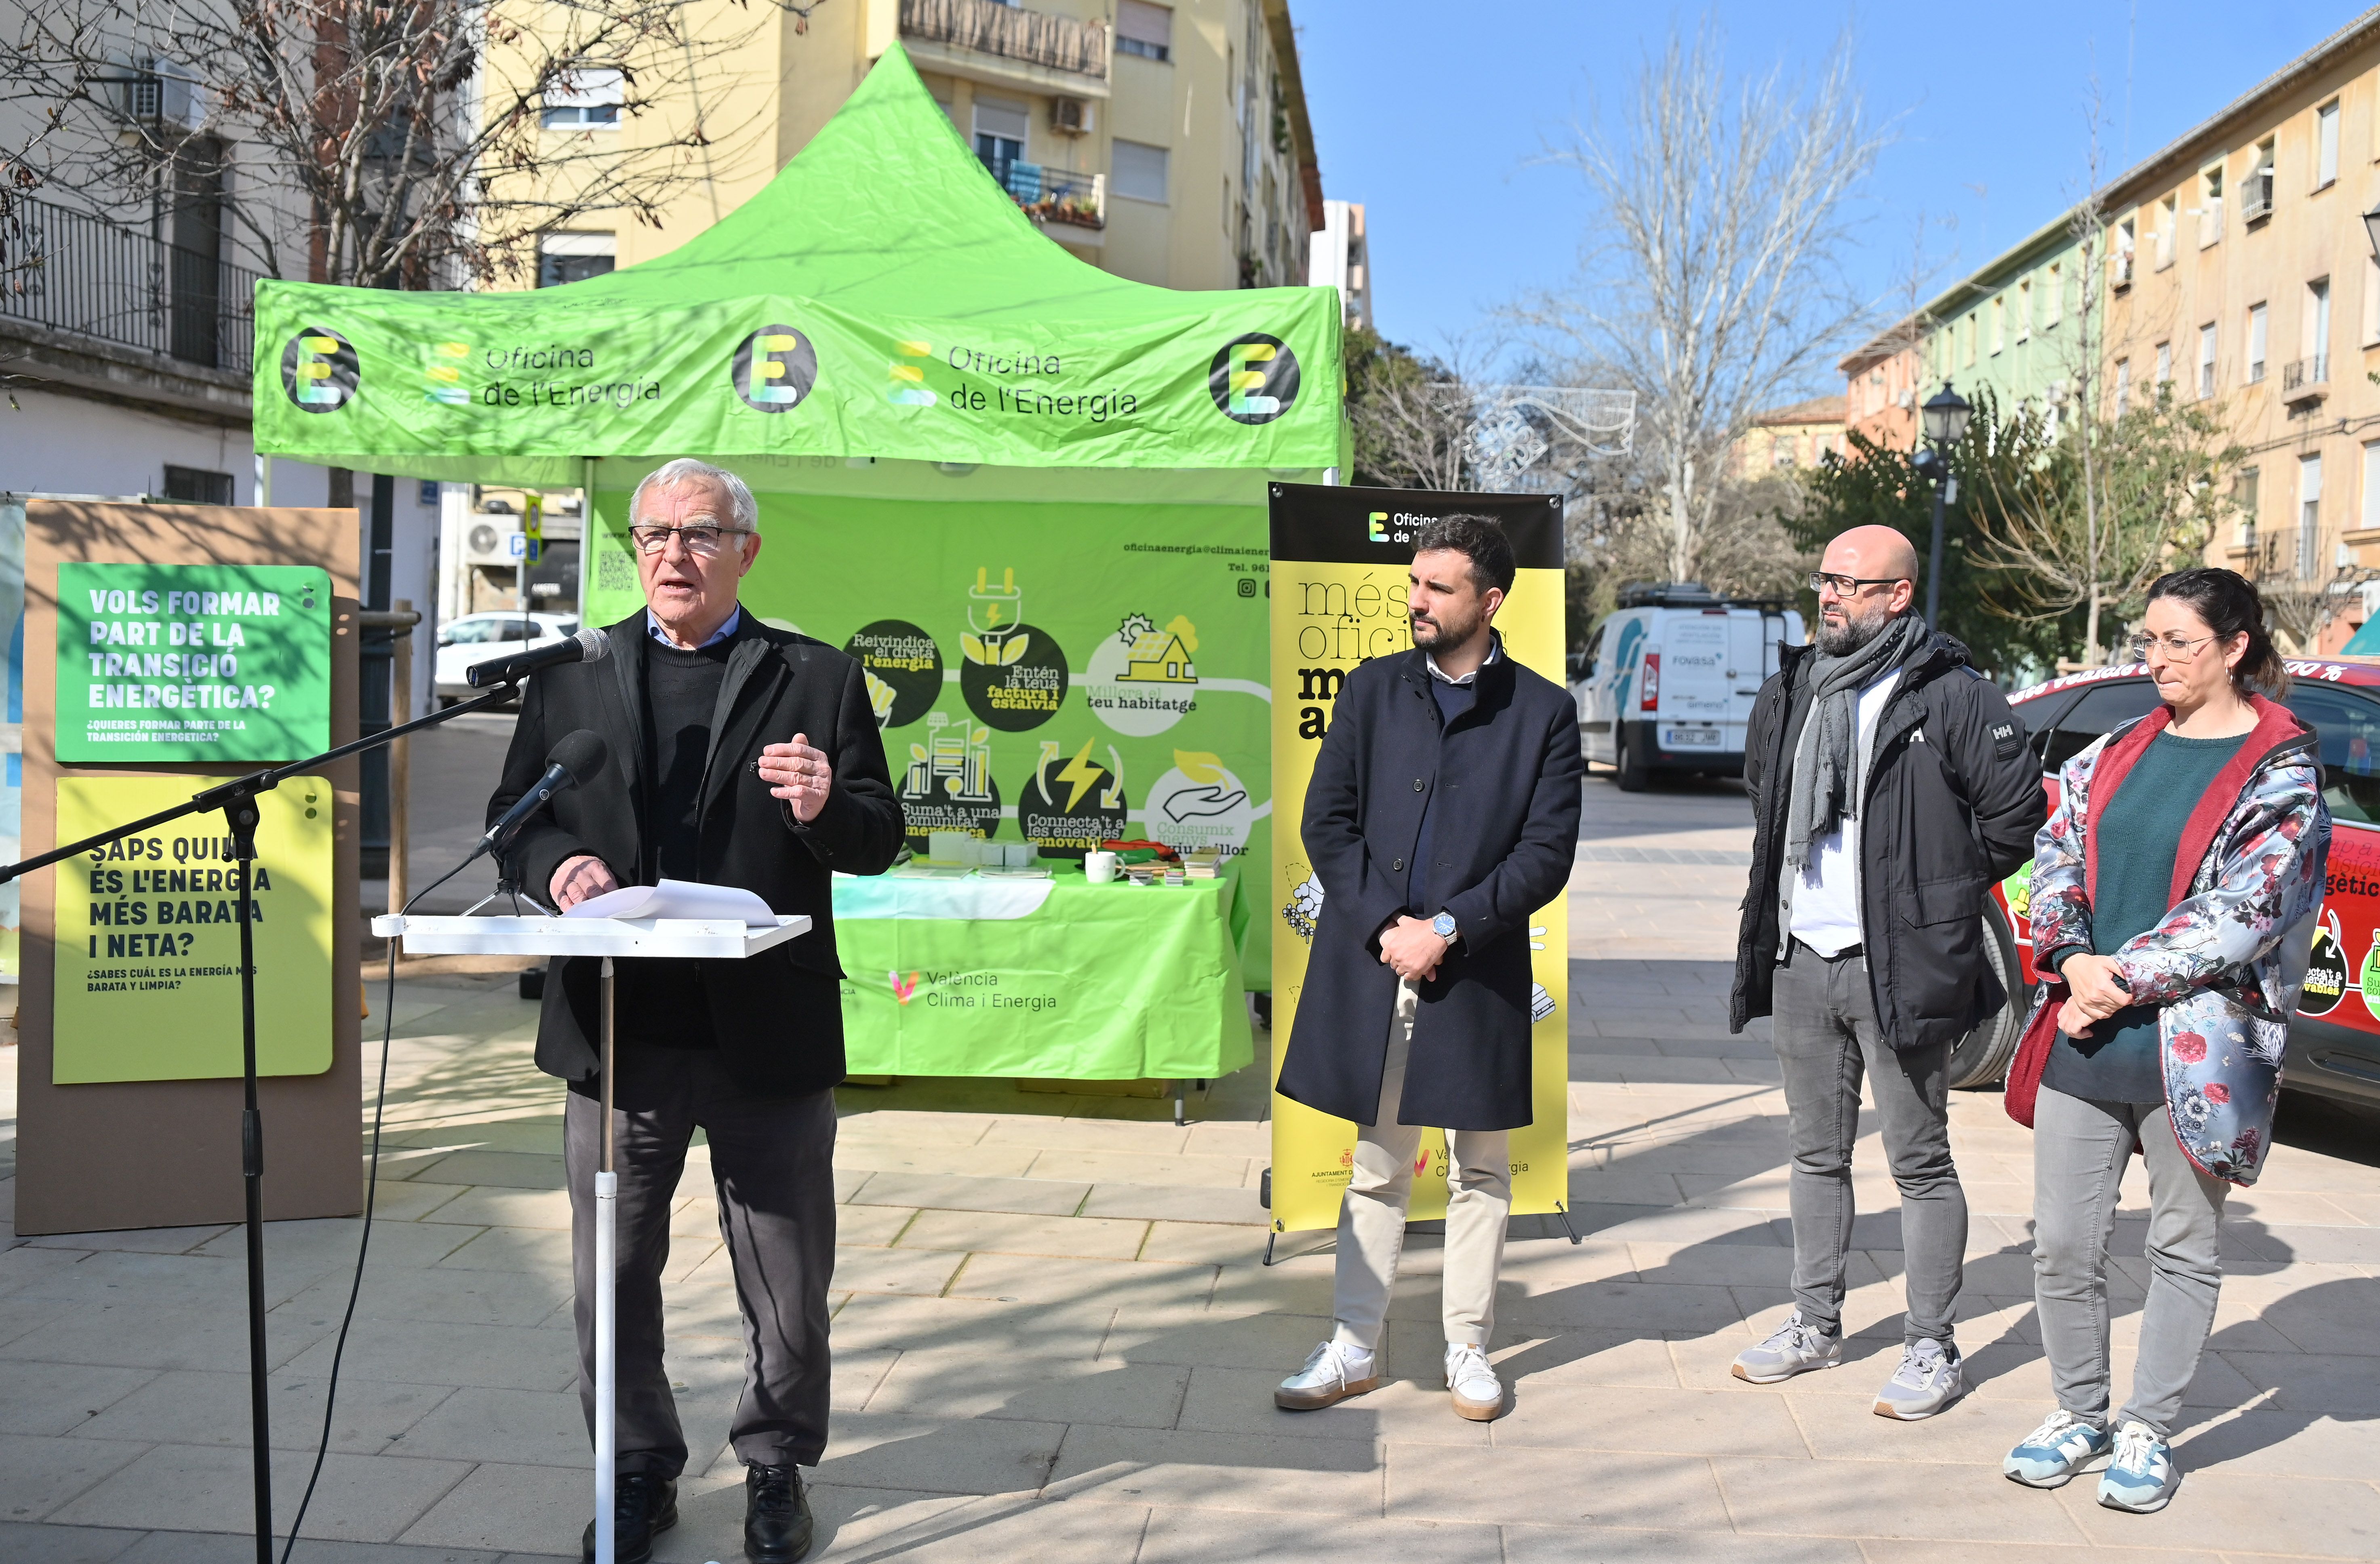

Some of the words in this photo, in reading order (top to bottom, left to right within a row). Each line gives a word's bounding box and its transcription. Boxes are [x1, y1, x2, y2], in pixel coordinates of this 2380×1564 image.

[486, 345, 594, 369] Oficina
[948, 345, 1061, 375] Oficina
[485, 382, 519, 406] de
[533, 376, 661, 409] l'Energia
[951, 383, 986, 411] de
[1000, 386, 1137, 423] l'Energia
[1394, 530, 1409, 543] de
[1123, 543, 1269, 555] oficinaenergia@climaiener
[1228, 563, 1248, 571] Tel.
[1251, 563, 1269, 572] 961
[90, 589, 158, 614] VOLS
[168, 591, 280, 615] FORMAR
[1298, 572, 1408, 618] més
[91, 621, 160, 645] PART
[169, 623, 204, 646] DE
[213, 623, 245, 647] LA
[853, 634, 936, 649] Reivindica
[875, 646, 889, 658] el
[89, 647, 237, 677] TRANSICIÓ
[863, 654, 934, 672] l'energia
[1011, 665, 1059, 679] Entén
[2283, 661, 2321, 677] 00
[2319, 665, 2348, 682] %
[1006, 675, 1022, 688] la
[1024, 677, 1059, 689] teua
[89, 678, 275, 708] ENERGÈTICA?
[987, 685, 1048, 700] factura
[1051, 688, 1059, 700] i
[1088, 686, 1144, 699] Millora
[1148, 688, 1161, 699] el
[991, 697, 1058, 710] estalvia
[1087, 697, 1113, 708] teu
[1118, 697, 1197, 713] habitatge
[87, 720, 137, 730] ¿QUIERES
[139, 720, 181, 729] FORMAR
[183, 720, 215, 730] PARTE
[218, 721, 231, 730] DE
[233, 721, 245, 730] LA
[1299, 706, 1327, 739] a
[87, 730, 148, 742] TRANSICIÓN
[900, 802, 954, 817] Suma't
[957, 807, 968, 817] a
[970, 807, 1000, 819] una
[1115, 819, 1125, 829] a
[1157, 822, 1234, 835] Consumix
[1027, 825, 1049, 837] les
[1053, 826, 1120, 839] energies
[1157, 834, 1207, 846] menys
[89, 837, 163, 861] SAPS
[90, 863, 123, 893] ÉS
[133, 868, 271, 893] L'ENERGA
[2325, 872, 2380, 897] gètic
[90, 895, 147, 925] MÉS
[89, 935, 96, 958] I
[107, 933, 194, 958] NETA?
[87, 969, 126, 979] ¿SABES
[130, 966, 156, 978] CUÁL
[159, 968, 171, 977] ES
[174, 968, 186, 976] LA
[190, 964, 233, 976] ENERGÍA
[236, 966, 257, 975] MS
[927, 972, 998, 986] València
[87, 982, 127, 991] BARATA
[130, 982, 137, 990] Y
[139, 980, 181, 991] LIMPIA?
[2302, 982, 2340, 996] vables
[927, 992, 975, 1008] Clima
[982, 993, 985, 1007] i
[992, 993, 1056, 1012] Energia
[1436, 1149, 1448, 1160] Va
